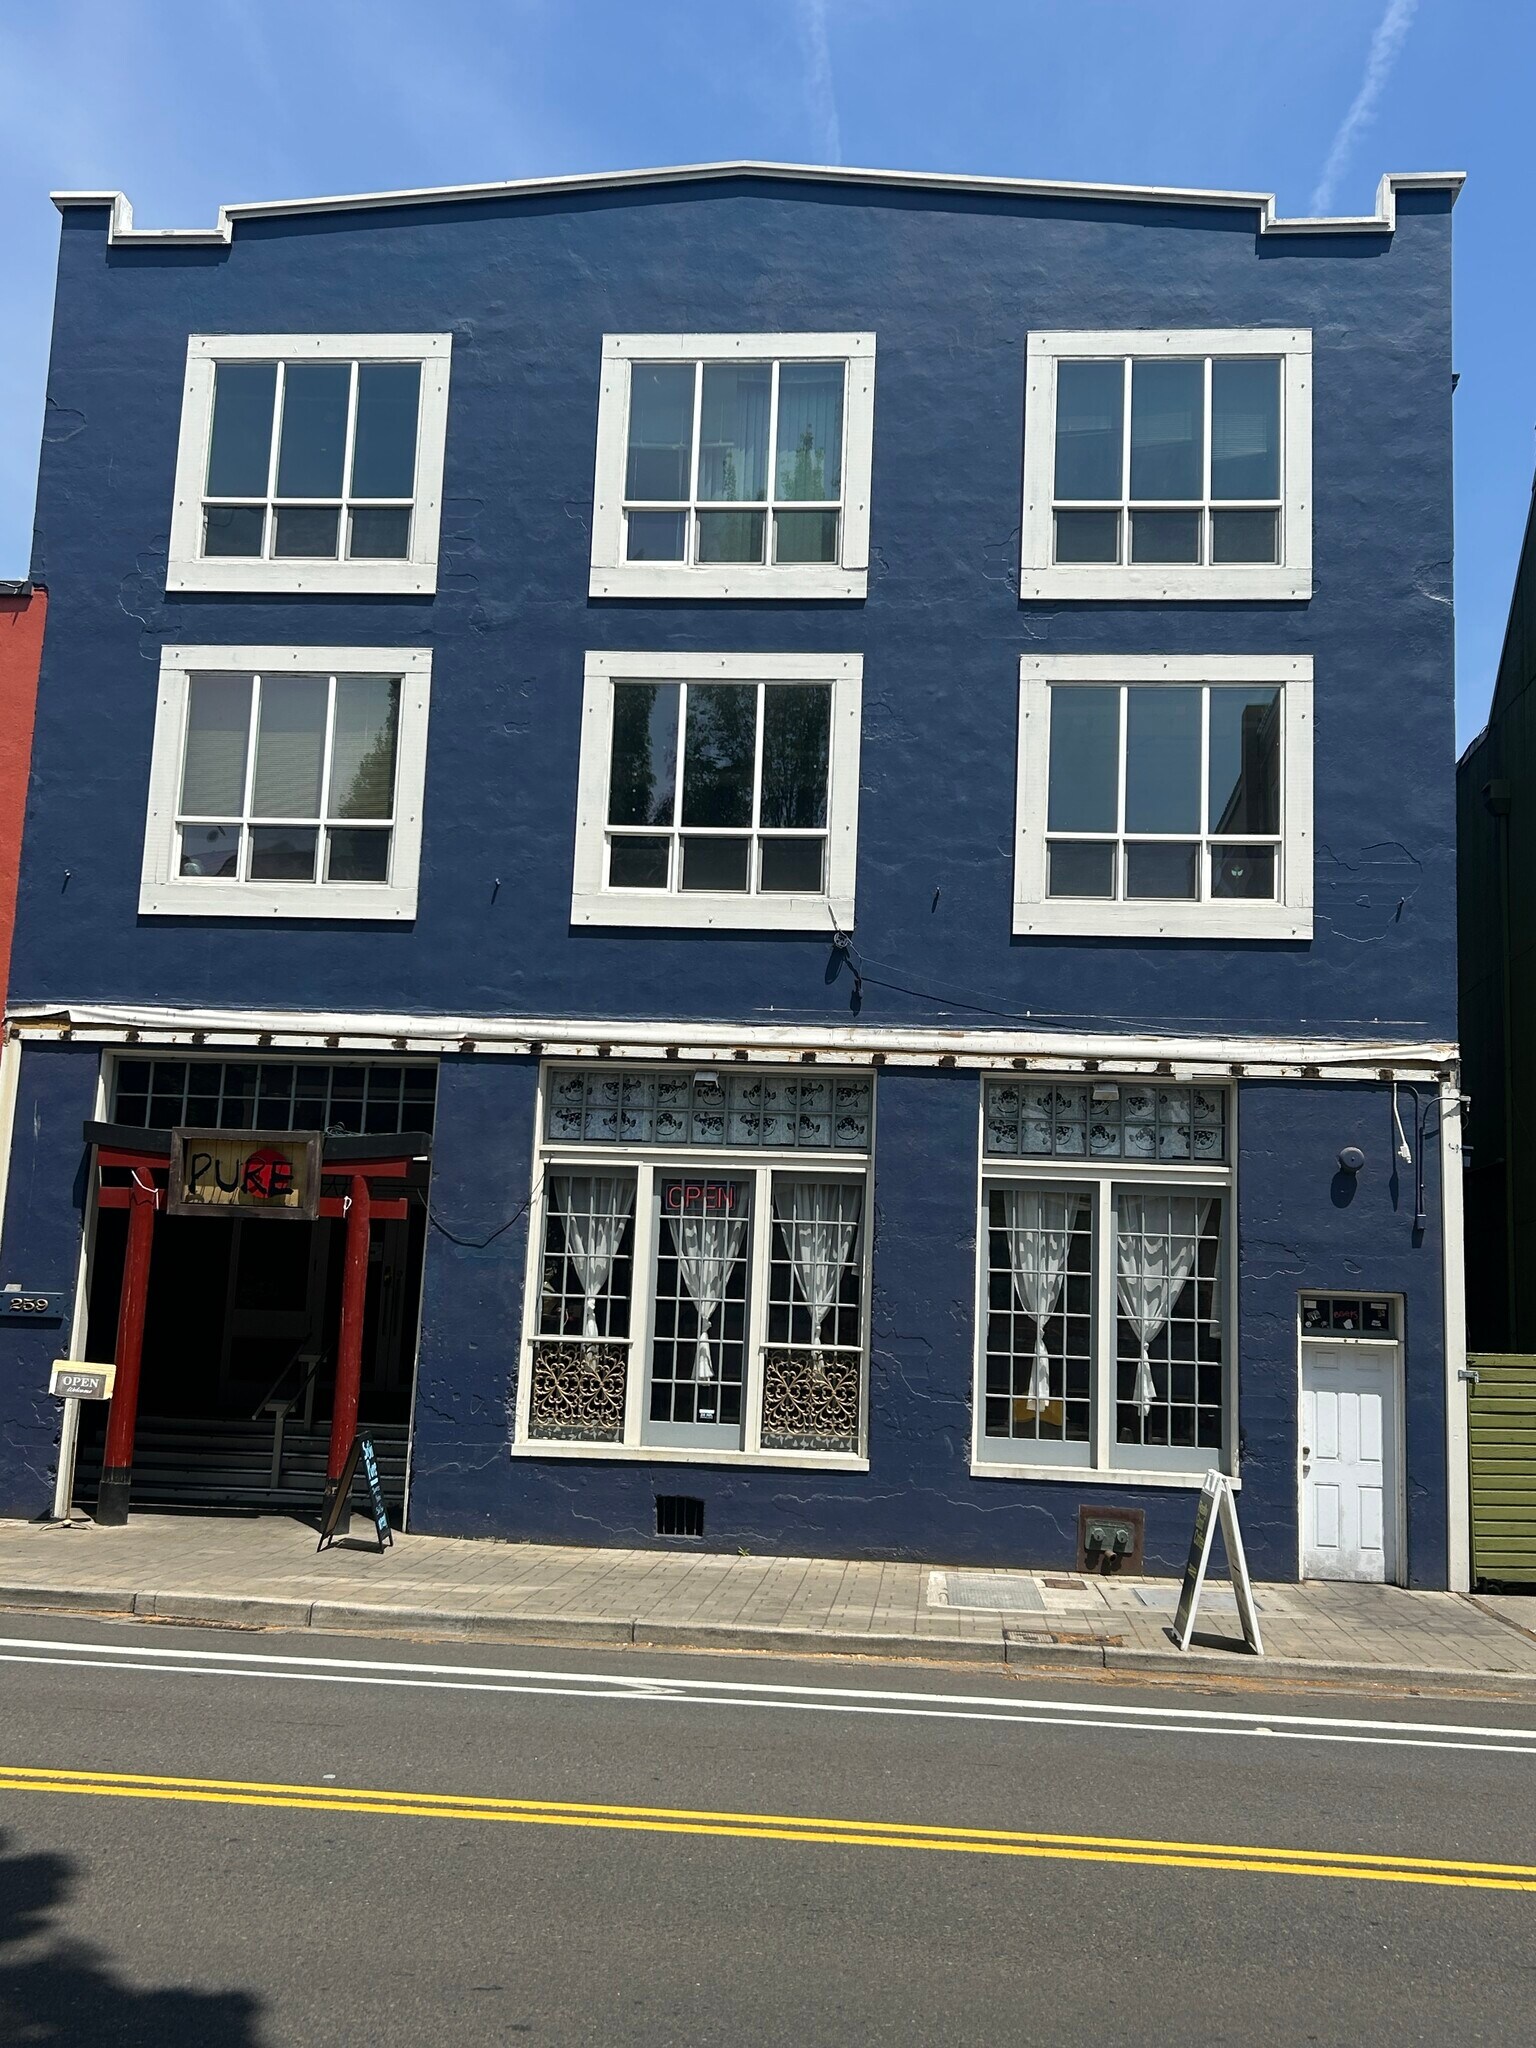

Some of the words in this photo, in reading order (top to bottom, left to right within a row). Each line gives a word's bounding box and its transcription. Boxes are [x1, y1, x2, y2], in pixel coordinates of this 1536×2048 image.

[188, 1153, 294, 1197] PURE
[668, 1186, 733, 1208] OPEN
[10, 1297, 49, 1311] 259
[63, 1376, 100, 1388] OPEN
